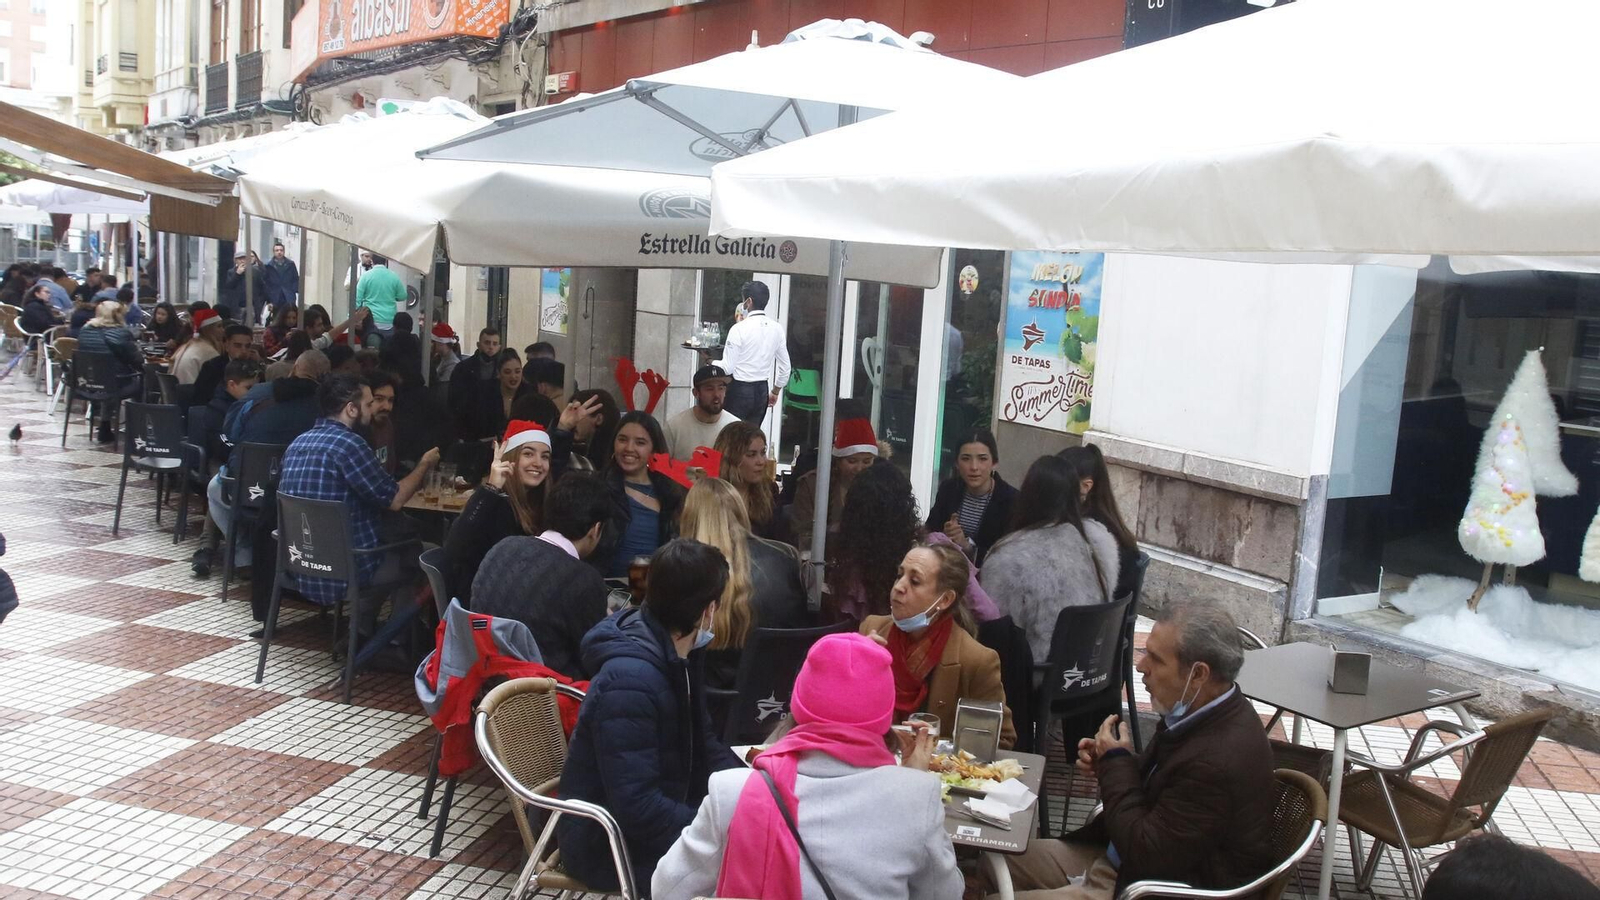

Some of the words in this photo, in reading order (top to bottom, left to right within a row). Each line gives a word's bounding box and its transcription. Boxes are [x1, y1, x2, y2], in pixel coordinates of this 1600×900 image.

[638, 232, 711, 255] Estrella
[715, 236, 776, 259] Galicia
[1011, 355, 1023, 365] DE
[1024, 357, 1051, 369] TAPAS
[310, 563, 332, 572] TAPAS
